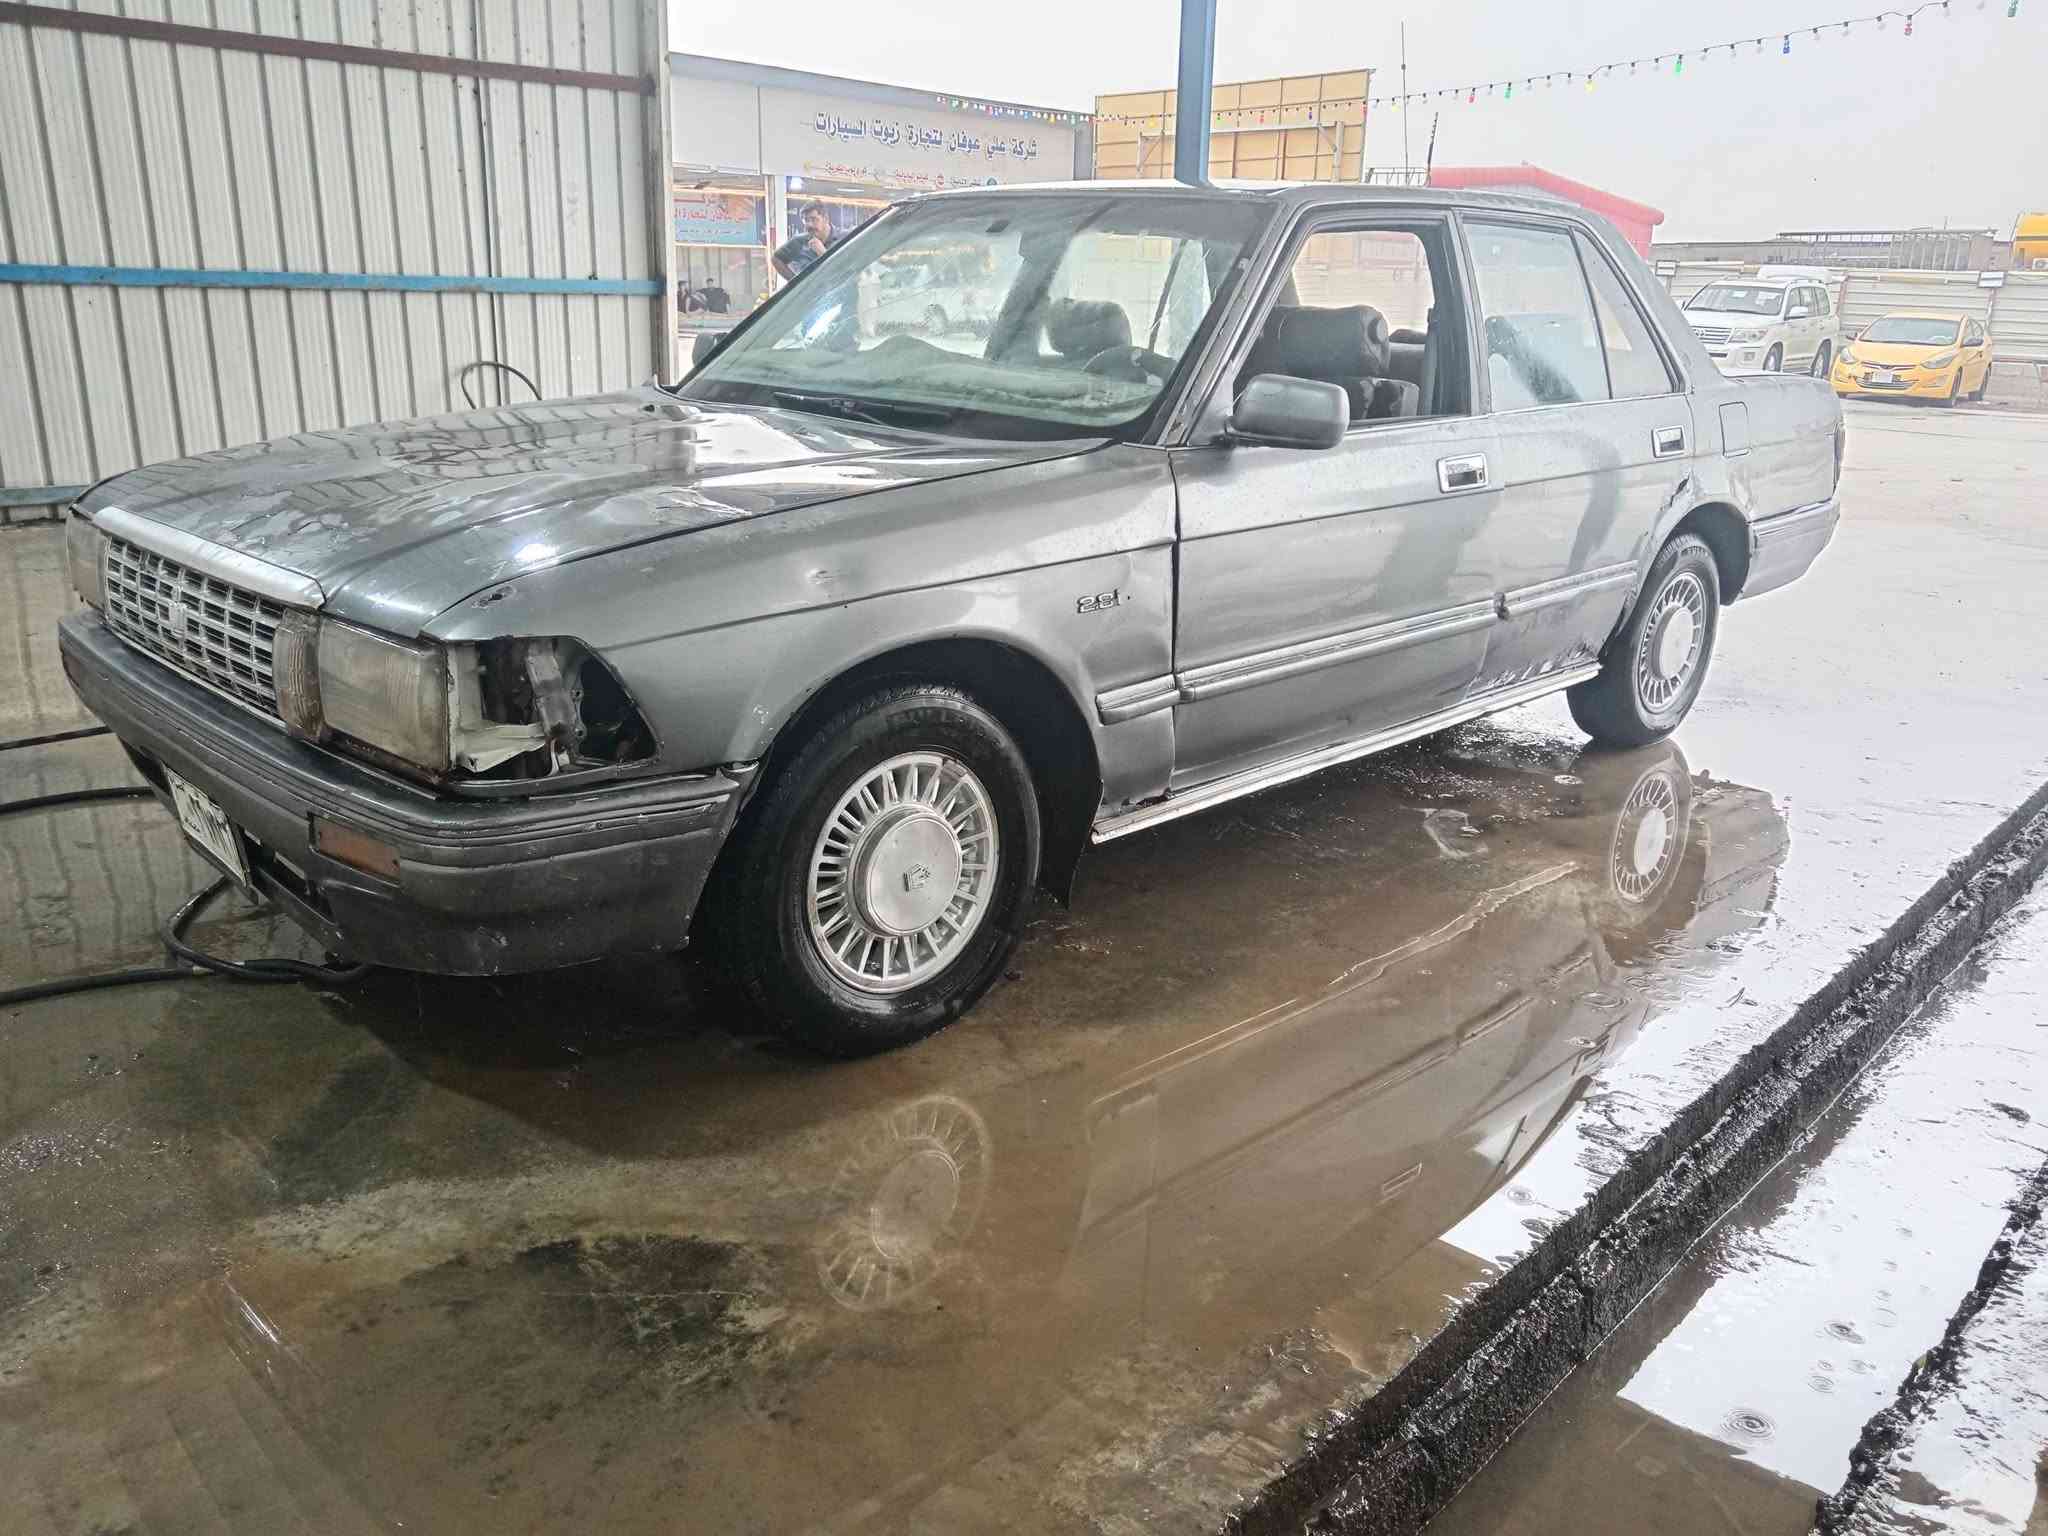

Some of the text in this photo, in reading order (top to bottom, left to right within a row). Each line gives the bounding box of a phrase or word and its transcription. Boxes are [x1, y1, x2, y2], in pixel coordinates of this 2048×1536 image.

[814, 111, 867, 142] السيارات
[872, 119, 901, 146] زيوت
[907, 124, 944, 149] لتجارة
[986, 139, 1007, 160] علي
[1011, 138, 1037, 160] شركة
